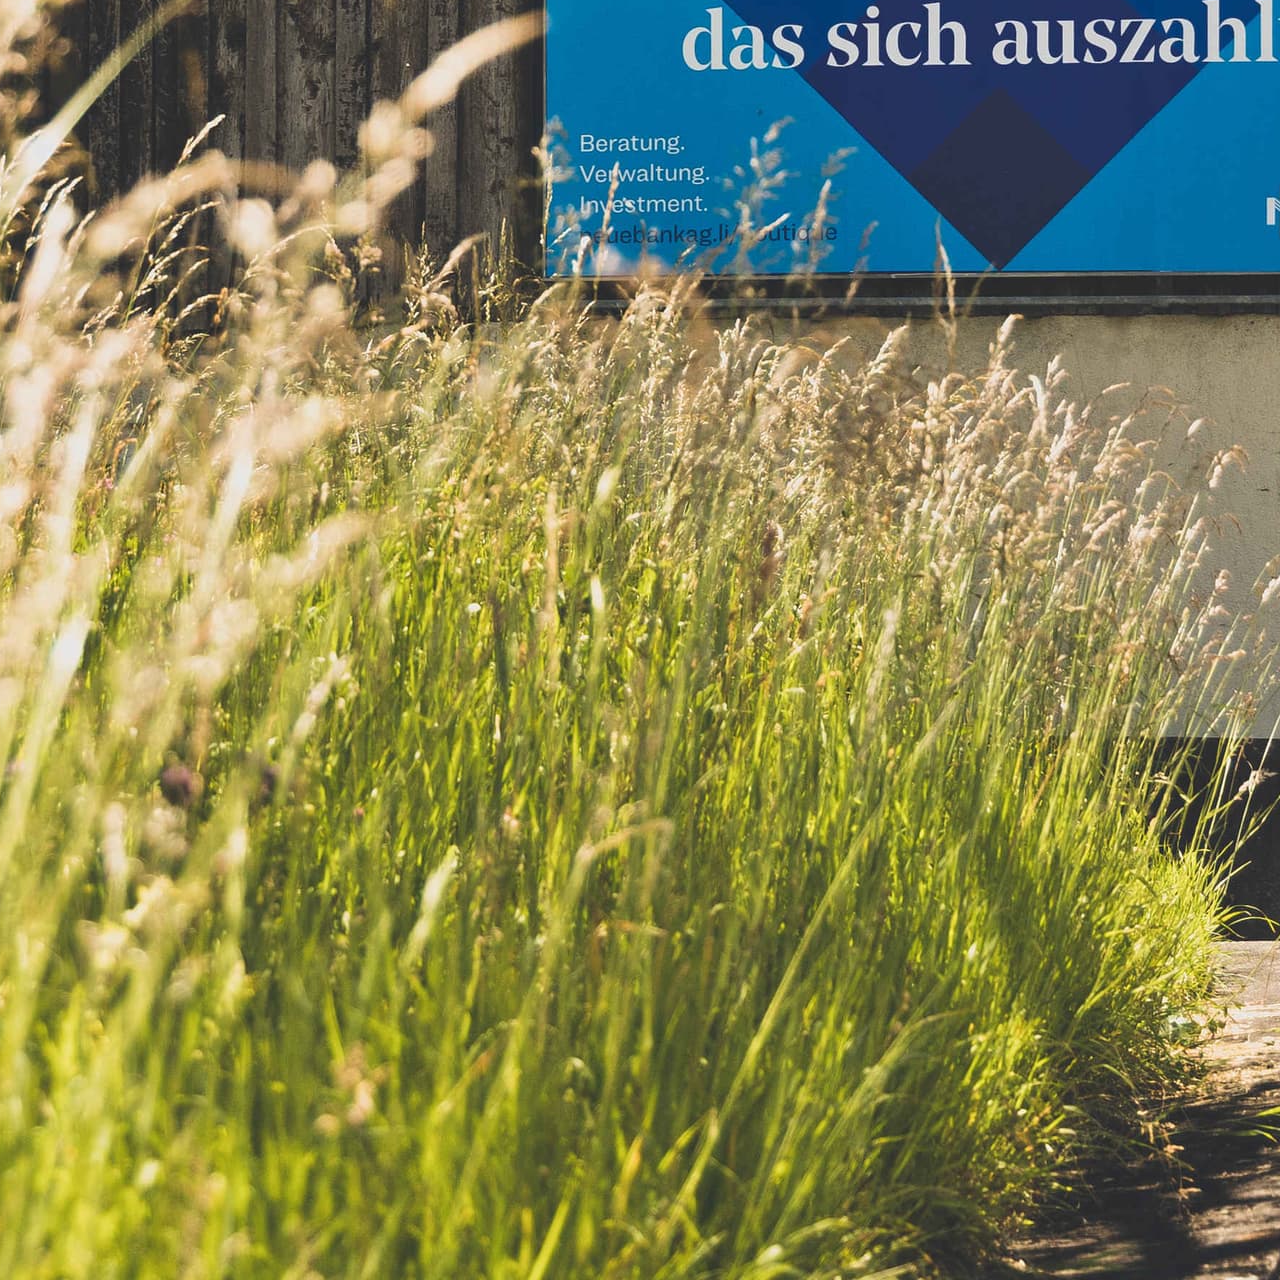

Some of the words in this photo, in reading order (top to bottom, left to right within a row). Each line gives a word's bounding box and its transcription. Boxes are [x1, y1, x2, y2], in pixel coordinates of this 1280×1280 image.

[681, 6, 805, 72] das
[826, 2, 972, 68] sich
[579, 134, 685, 153] Beratung.
[580, 195, 708, 214] Investment.
